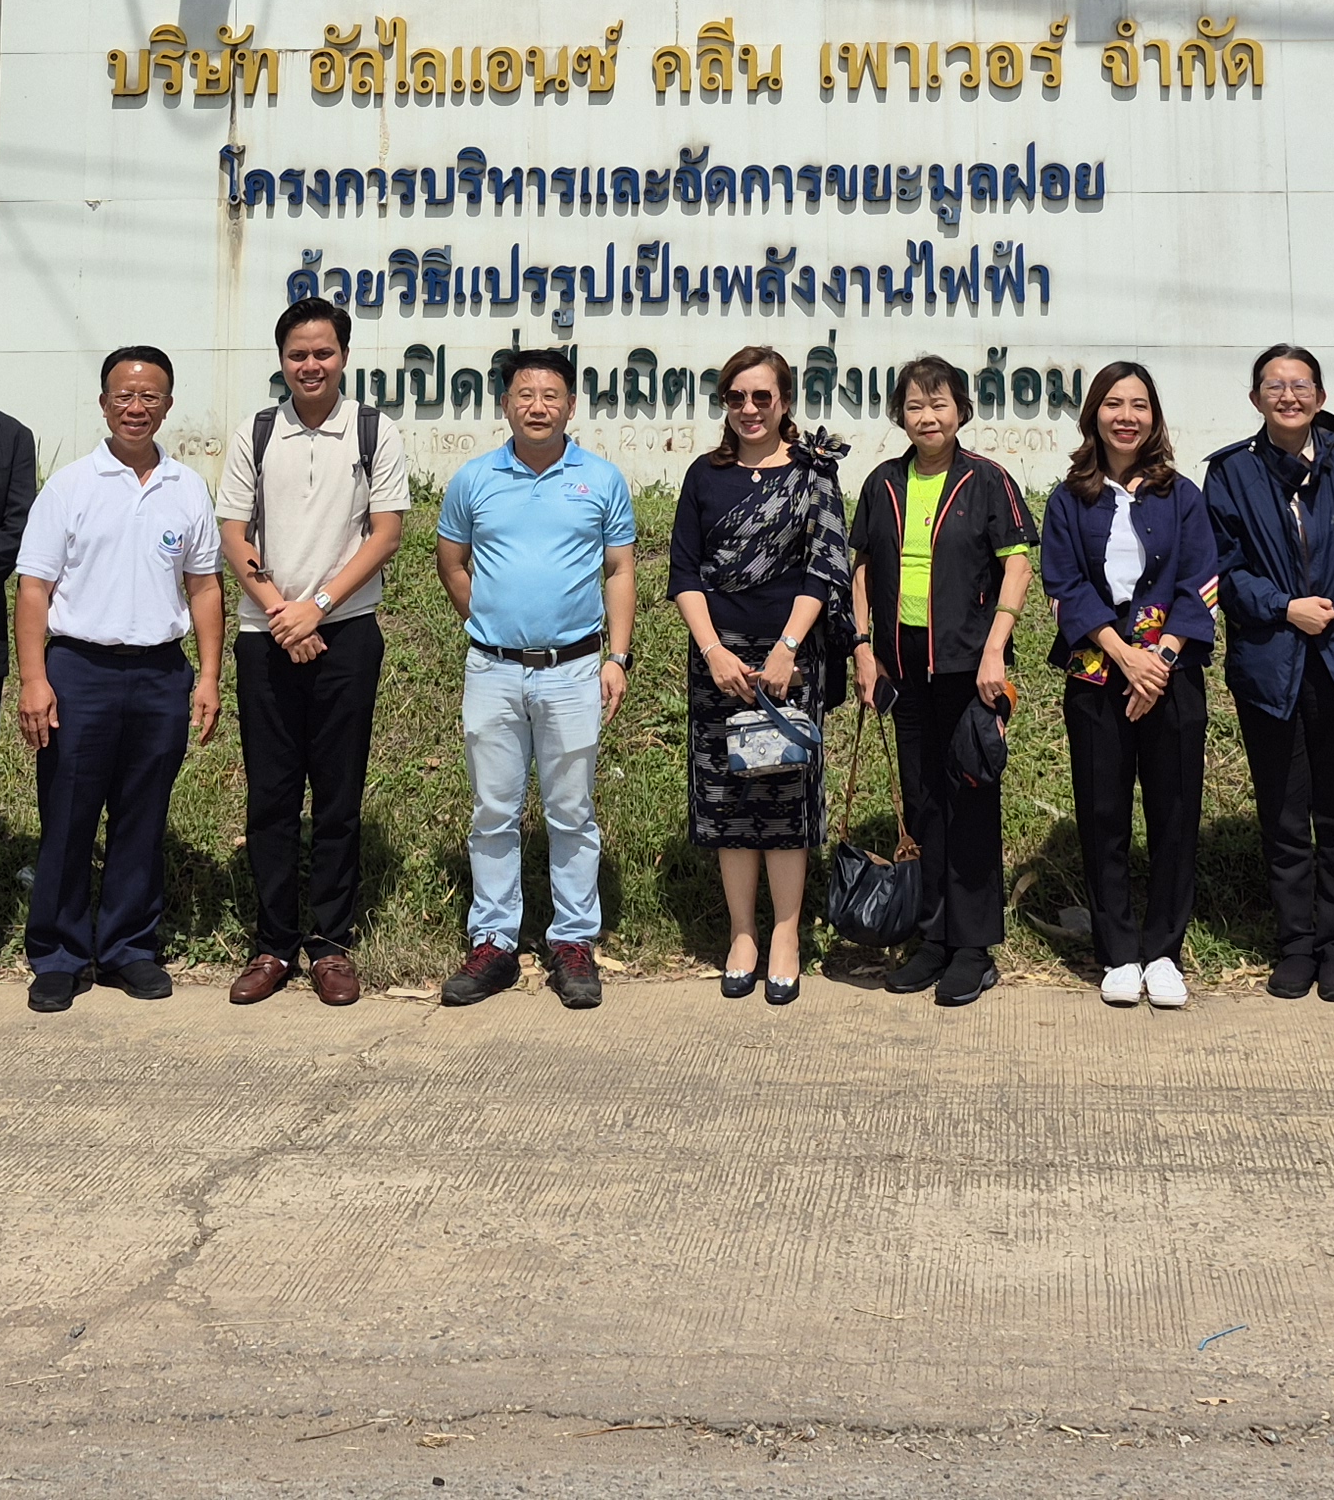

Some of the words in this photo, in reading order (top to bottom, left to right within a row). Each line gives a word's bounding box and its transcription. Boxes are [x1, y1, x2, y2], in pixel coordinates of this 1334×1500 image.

[107, 22, 280, 98] บริษัท
[309, 15, 624, 95] อัลไลแอนซ์
[651, 16, 783, 93] คลีน
[819, 14, 1070, 90] เพาเวอร์
[1100, 15, 1264, 88] จำกัด
[218, 140, 1107, 225] โครงการบริหารและจัดการขยะมูลฝอย
[285, 238, 1053, 328] ด้วยวิธีแปรรูปเป็นพลังงานไฟฟ้า
